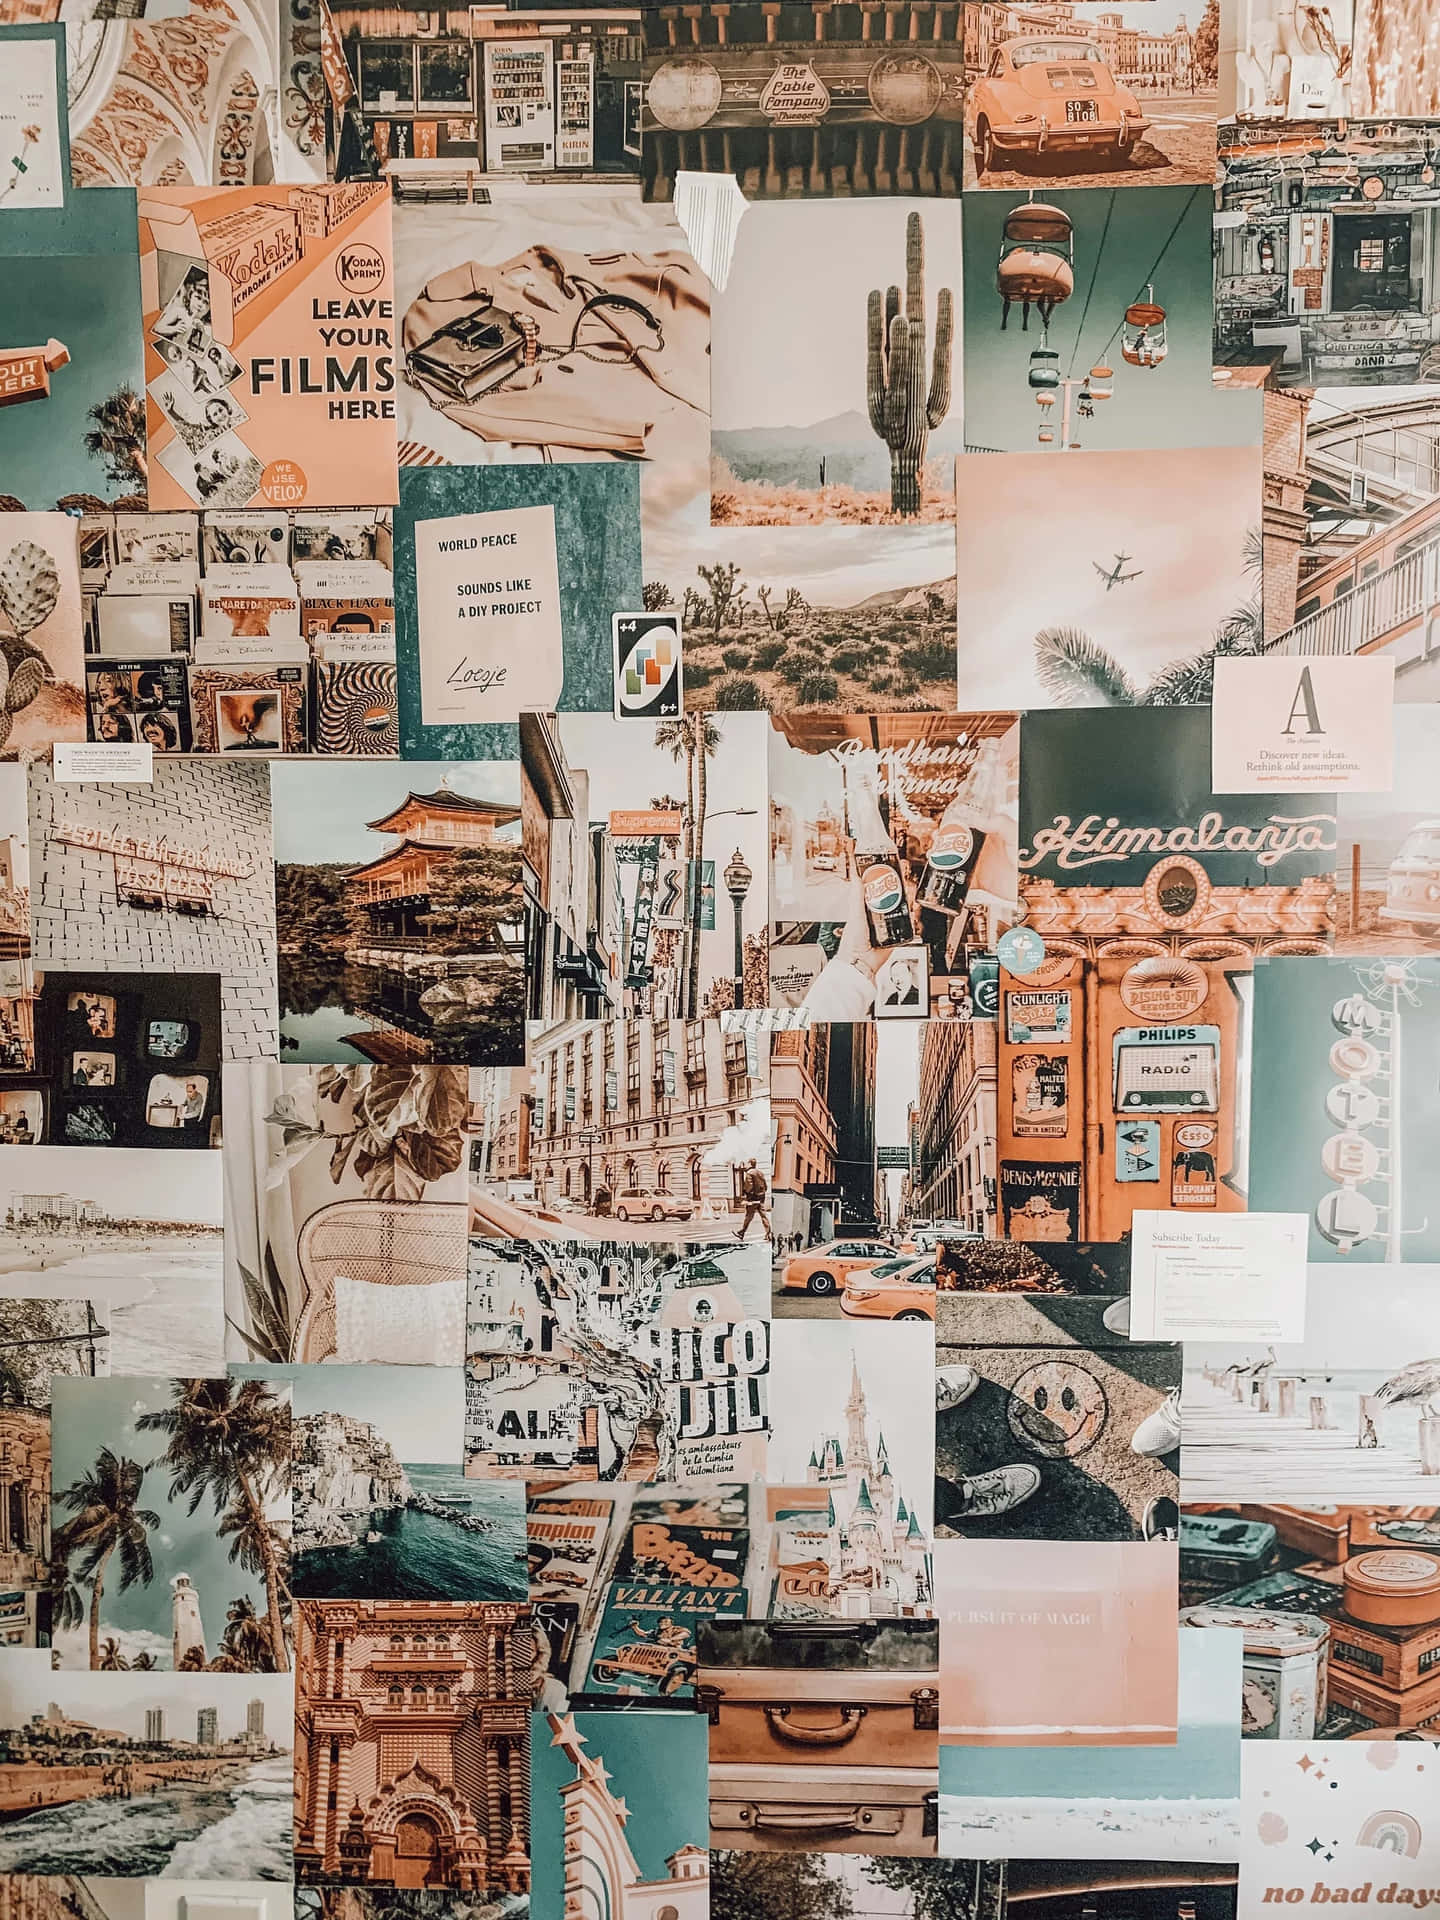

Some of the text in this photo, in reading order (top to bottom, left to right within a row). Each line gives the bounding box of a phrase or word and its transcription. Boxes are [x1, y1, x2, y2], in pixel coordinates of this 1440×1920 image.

[782, 66, 807, 80] The
[773, 81, 815, 96] Cable
[765, 96, 826, 110] Company
[562, 141, 589, 149] KIRIN
[217, 229, 293, 292] Kodak
[233, 254, 295, 308] ICHROME FILM
[312, 298, 393, 320] LEAVE
[319, 327, 393, 349] YOUR
[251, 356, 395, 395] FILMS
[328, 400, 396, 420] HERE
[275, 464, 292, 473] WE
[272, 474, 296, 483] USE
[263, 485, 304, 501] VELOX
[438, 533, 518, 552] WORLD PEACE
[457, 578, 532, 596] SOUNDS LIKE
[306, 598, 344, 609] BLACK
[458, 600, 542, 618] A DIY PROJECT
[1280, 665, 1327, 735] A
[1260, 750, 1299, 761] Discover
[1301, 752, 1321, 760] new
[1246, 762, 1283, 772] Rethink
[1286, 762, 1301, 771] old
[58, 822, 131, 851] PEOPLE
[1018, 812, 1337, 869] Himalaya
[632, 866, 656, 975] BAKERY
[1012, 993, 1068, 1006] SUNLIGHT
[1139, 1029, 1196, 1041] PHILIPS
[1142, 1065, 1191, 1075] RADIO
[1152, 1232, 1220, 1243] Subscribe Today
[615, 1588, 742, 1606] VALIANT
[1262, 1887, 1304, 1904] no
[1310, 1882, 1372, 1904] bad
